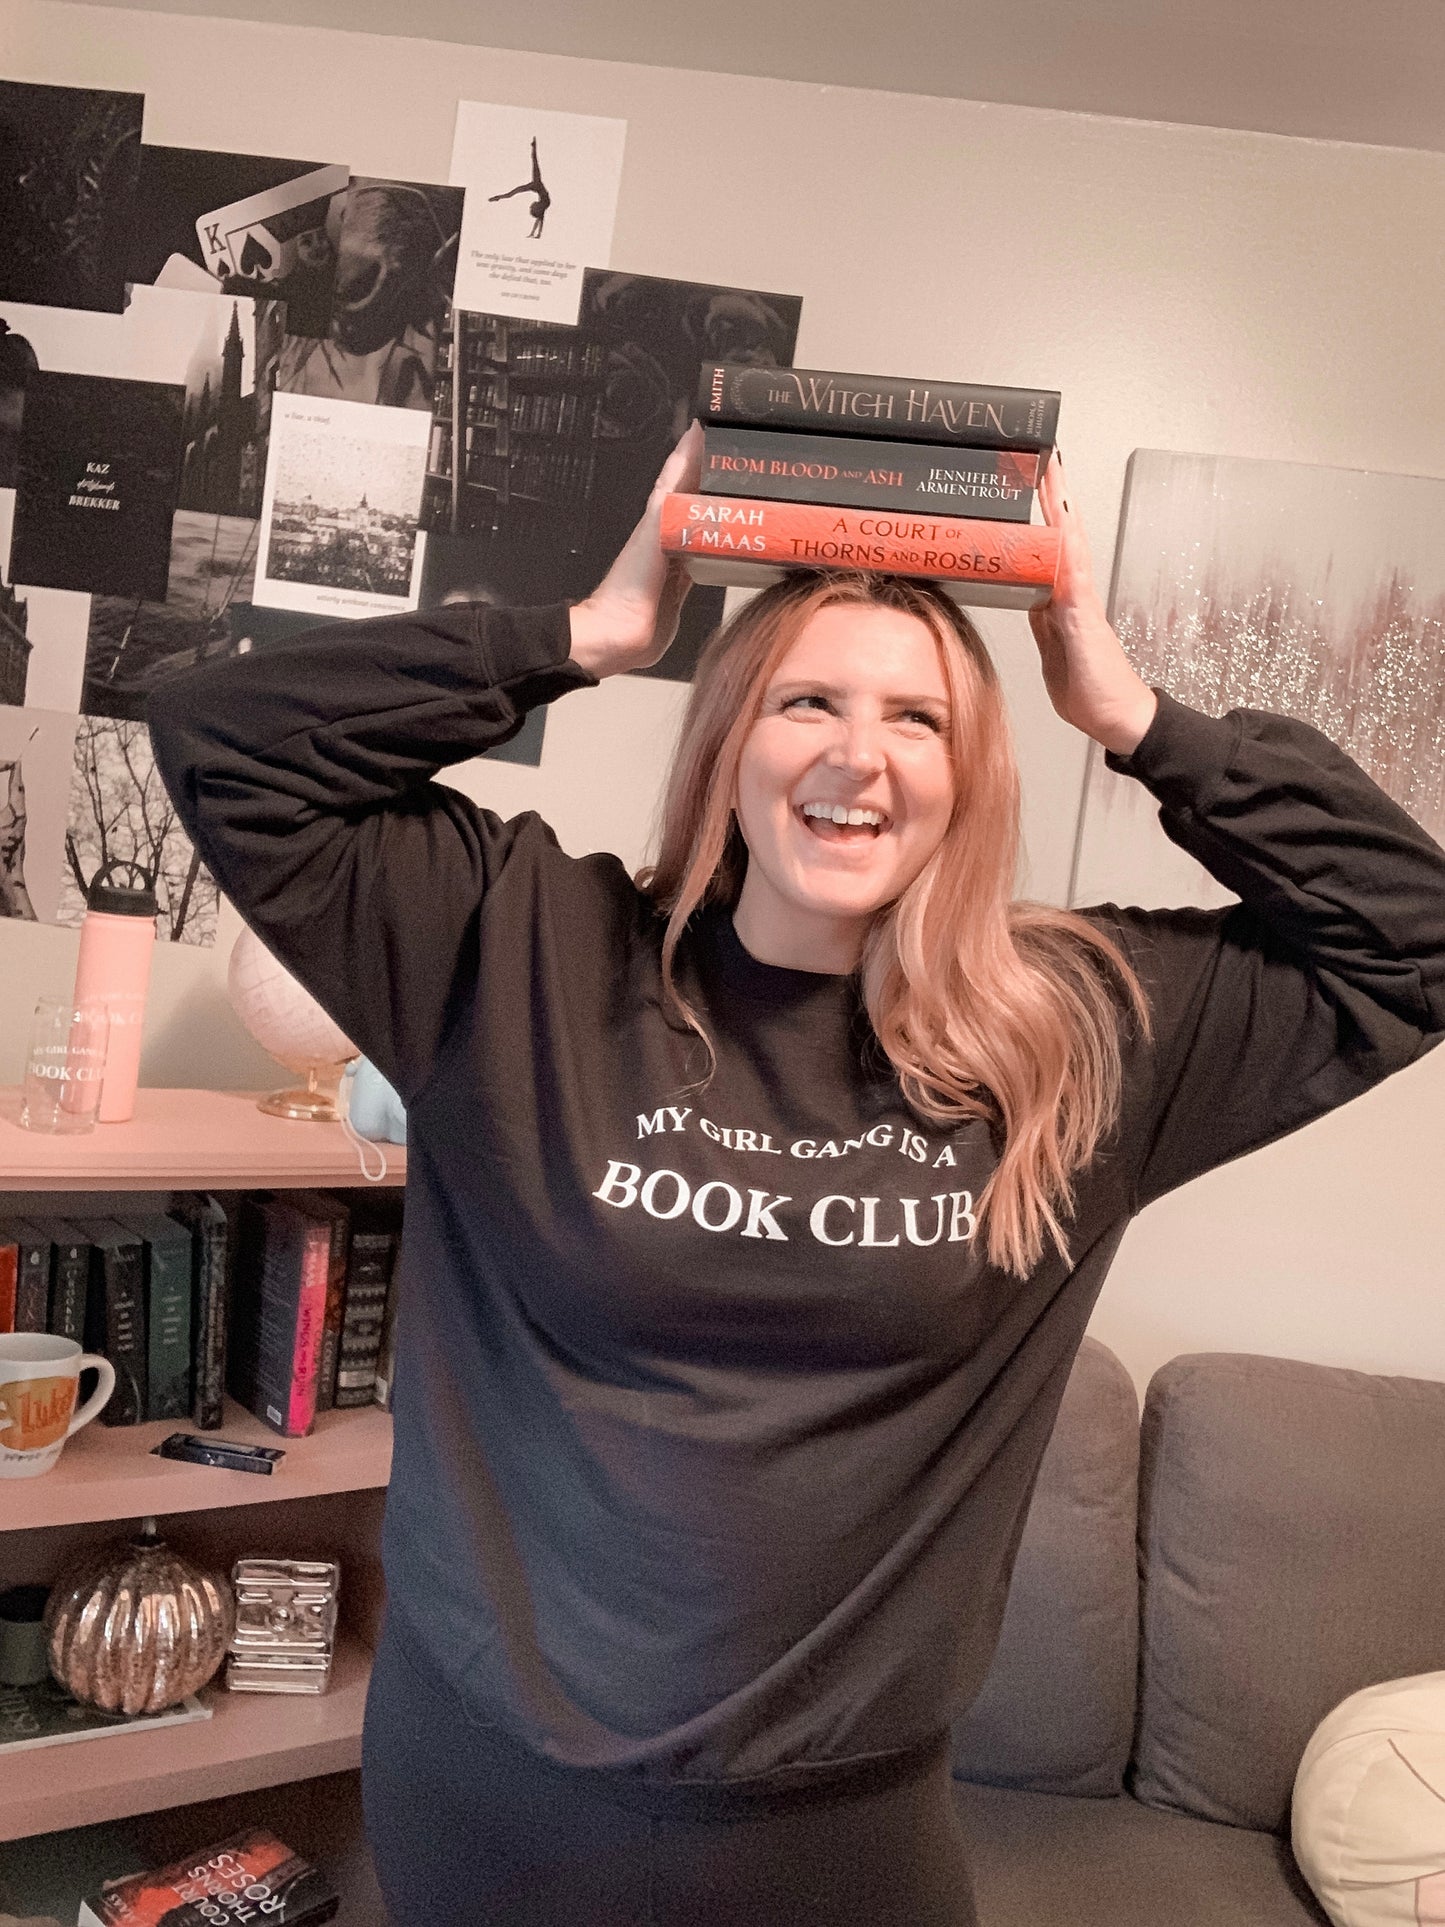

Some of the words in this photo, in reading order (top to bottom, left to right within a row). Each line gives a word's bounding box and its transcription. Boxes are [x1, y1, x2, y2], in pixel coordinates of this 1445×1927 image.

[204, 223, 227, 255] K
[710, 368, 725, 412] SMITH
[768, 389, 794, 404] THE
[905, 389, 1018, 438] HAVEN
[86, 462, 111, 474] KAZ
[710, 454, 766, 474] FROM
[770, 461, 838, 480] BLOOD
[842, 470, 863, 478] AND
[864, 469, 904, 487] ASH
[929, 468, 998, 485] JENNIFER
[69, 495, 121, 511] BREKKER
[916, 481, 1022, 501] ARMENTROUT
[688, 504, 764, 526] SARAH
[832, 518, 848, 534] A
[859, 519, 941, 541] COURT
[945, 529, 962, 540] OF
[681, 528, 692, 547] J.
[701, 530, 766, 552] MAAS
[790, 538, 885, 563] THORNS
[890, 550, 919, 563] AND
[924, 551, 1001, 574] ROSES
[636, 1106, 693, 1140] MY
[699, 1117, 782, 1154] GIRL
[790, 1123, 893, 1159] GANG
[898, 1127, 929, 1163] IS
[932, 1144, 958, 1169] A
[591, 1159, 793, 1241] BOOK
[809, 1190, 977, 1247] CLUB
[302, 1308, 312, 1348] WINGS
[188, 1866, 257, 1924] THORNS
[208, 1854, 286, 1914] ROSES
[171, 1882, 230, 1926] COURT
